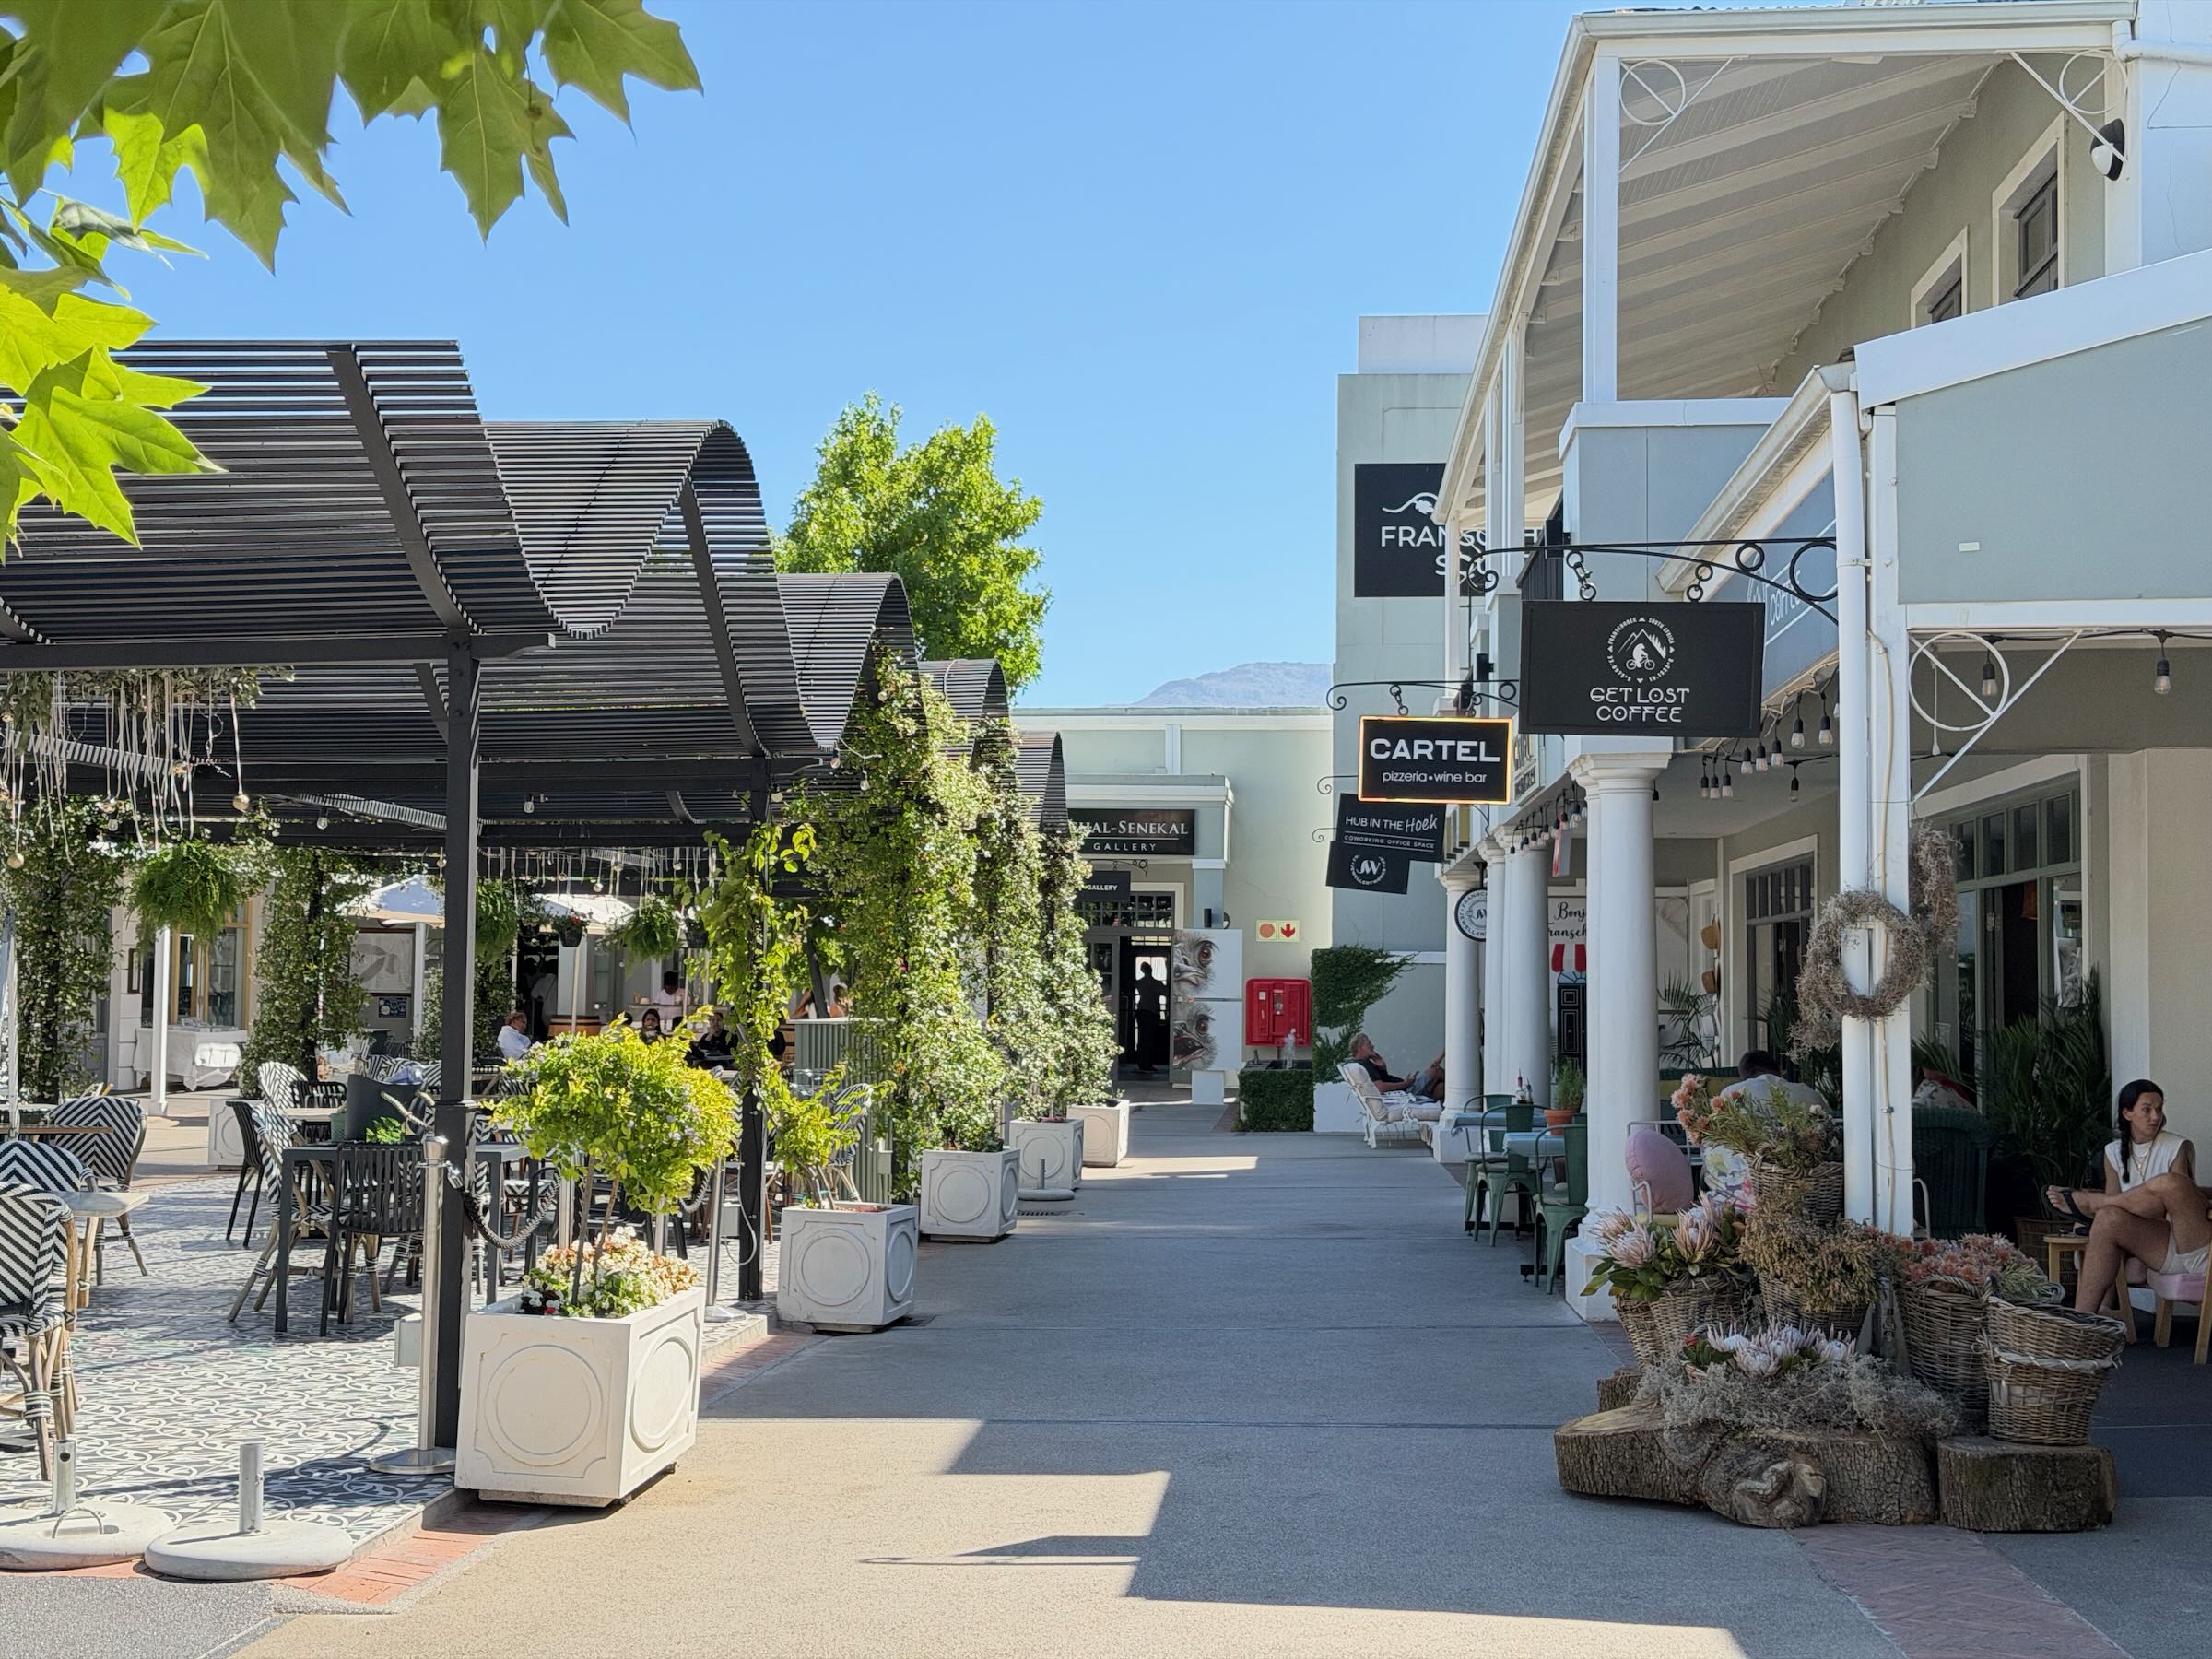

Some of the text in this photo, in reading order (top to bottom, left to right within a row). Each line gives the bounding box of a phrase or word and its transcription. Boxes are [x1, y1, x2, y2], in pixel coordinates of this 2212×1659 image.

[1590, 687, 1690, 704] GET LOST
[1596, 705, 1682, 723] COFFEE
[1370, 738, 1501, 763] CARTEL
[1382, 771, 1488, 783] pizzeria wine bar
[1072, 820, 1189, 835] HAL-SENEKAL
[1346, 814, 1438, 833] HUB IN THE Hoek
[1093, 842, 1157, 852] GALLERY
[1344, 834, 1384, 844] COWORKING
[1386, 839, 1411, 847] OFFICE
